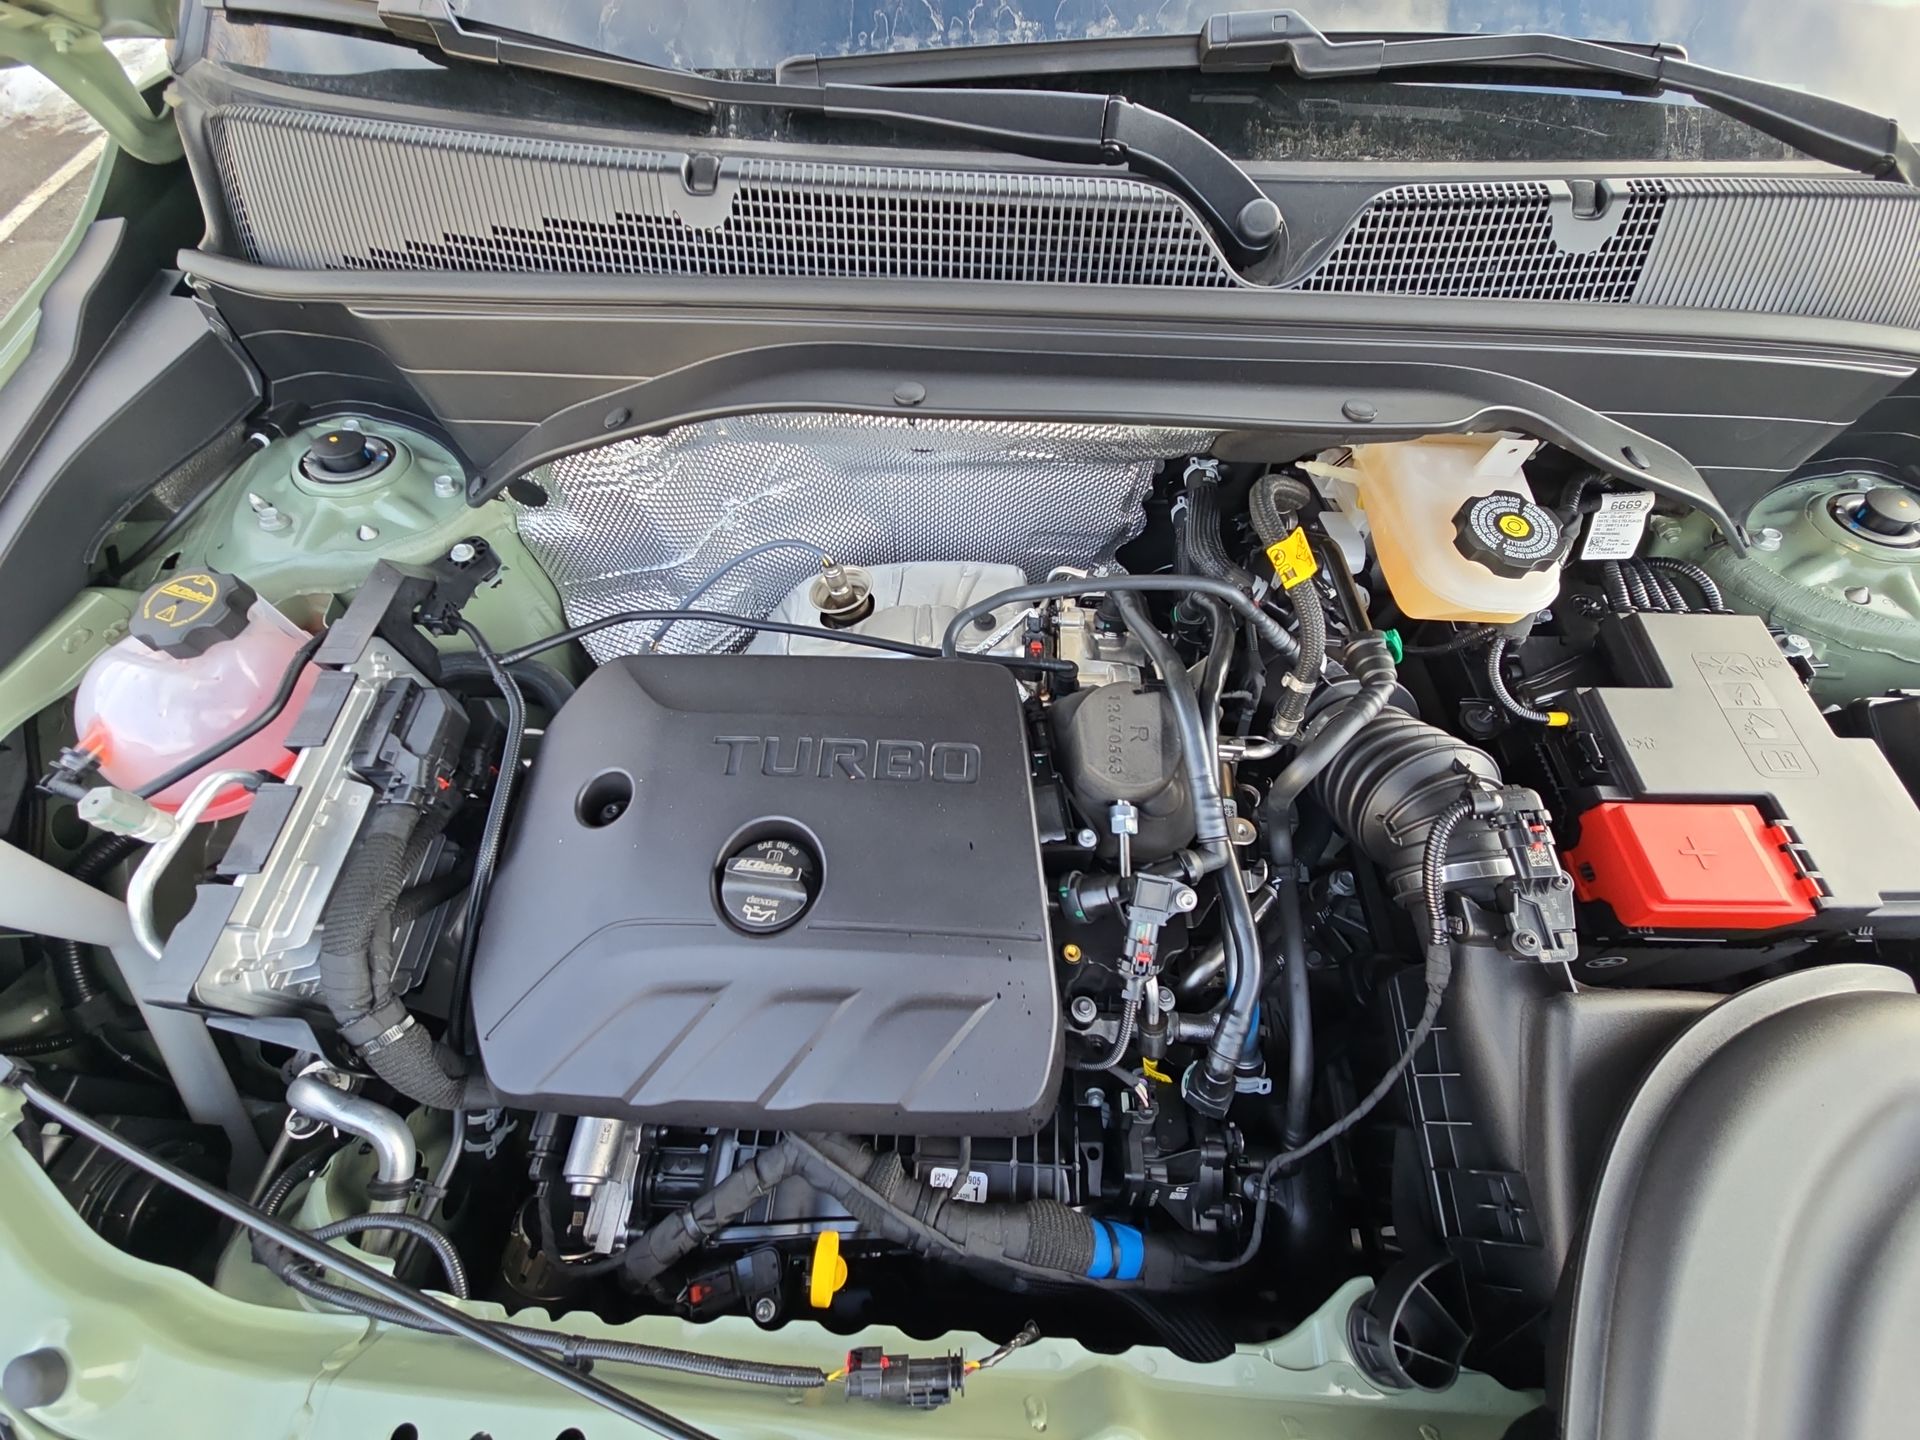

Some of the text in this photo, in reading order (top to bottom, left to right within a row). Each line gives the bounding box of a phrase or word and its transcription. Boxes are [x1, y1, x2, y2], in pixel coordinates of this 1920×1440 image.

[1611, 500, 1642, 510] 6669
[1108, 695, 1122, 775] 12670563
[1130, 726, 1149, 742] R
[713, 736, 981, 784] TURBO
[757, 841, 800, 856] SAE 0W-20
[732, 859, 794, 876] ACDelco
[746, 896, 780, 907] dexos
